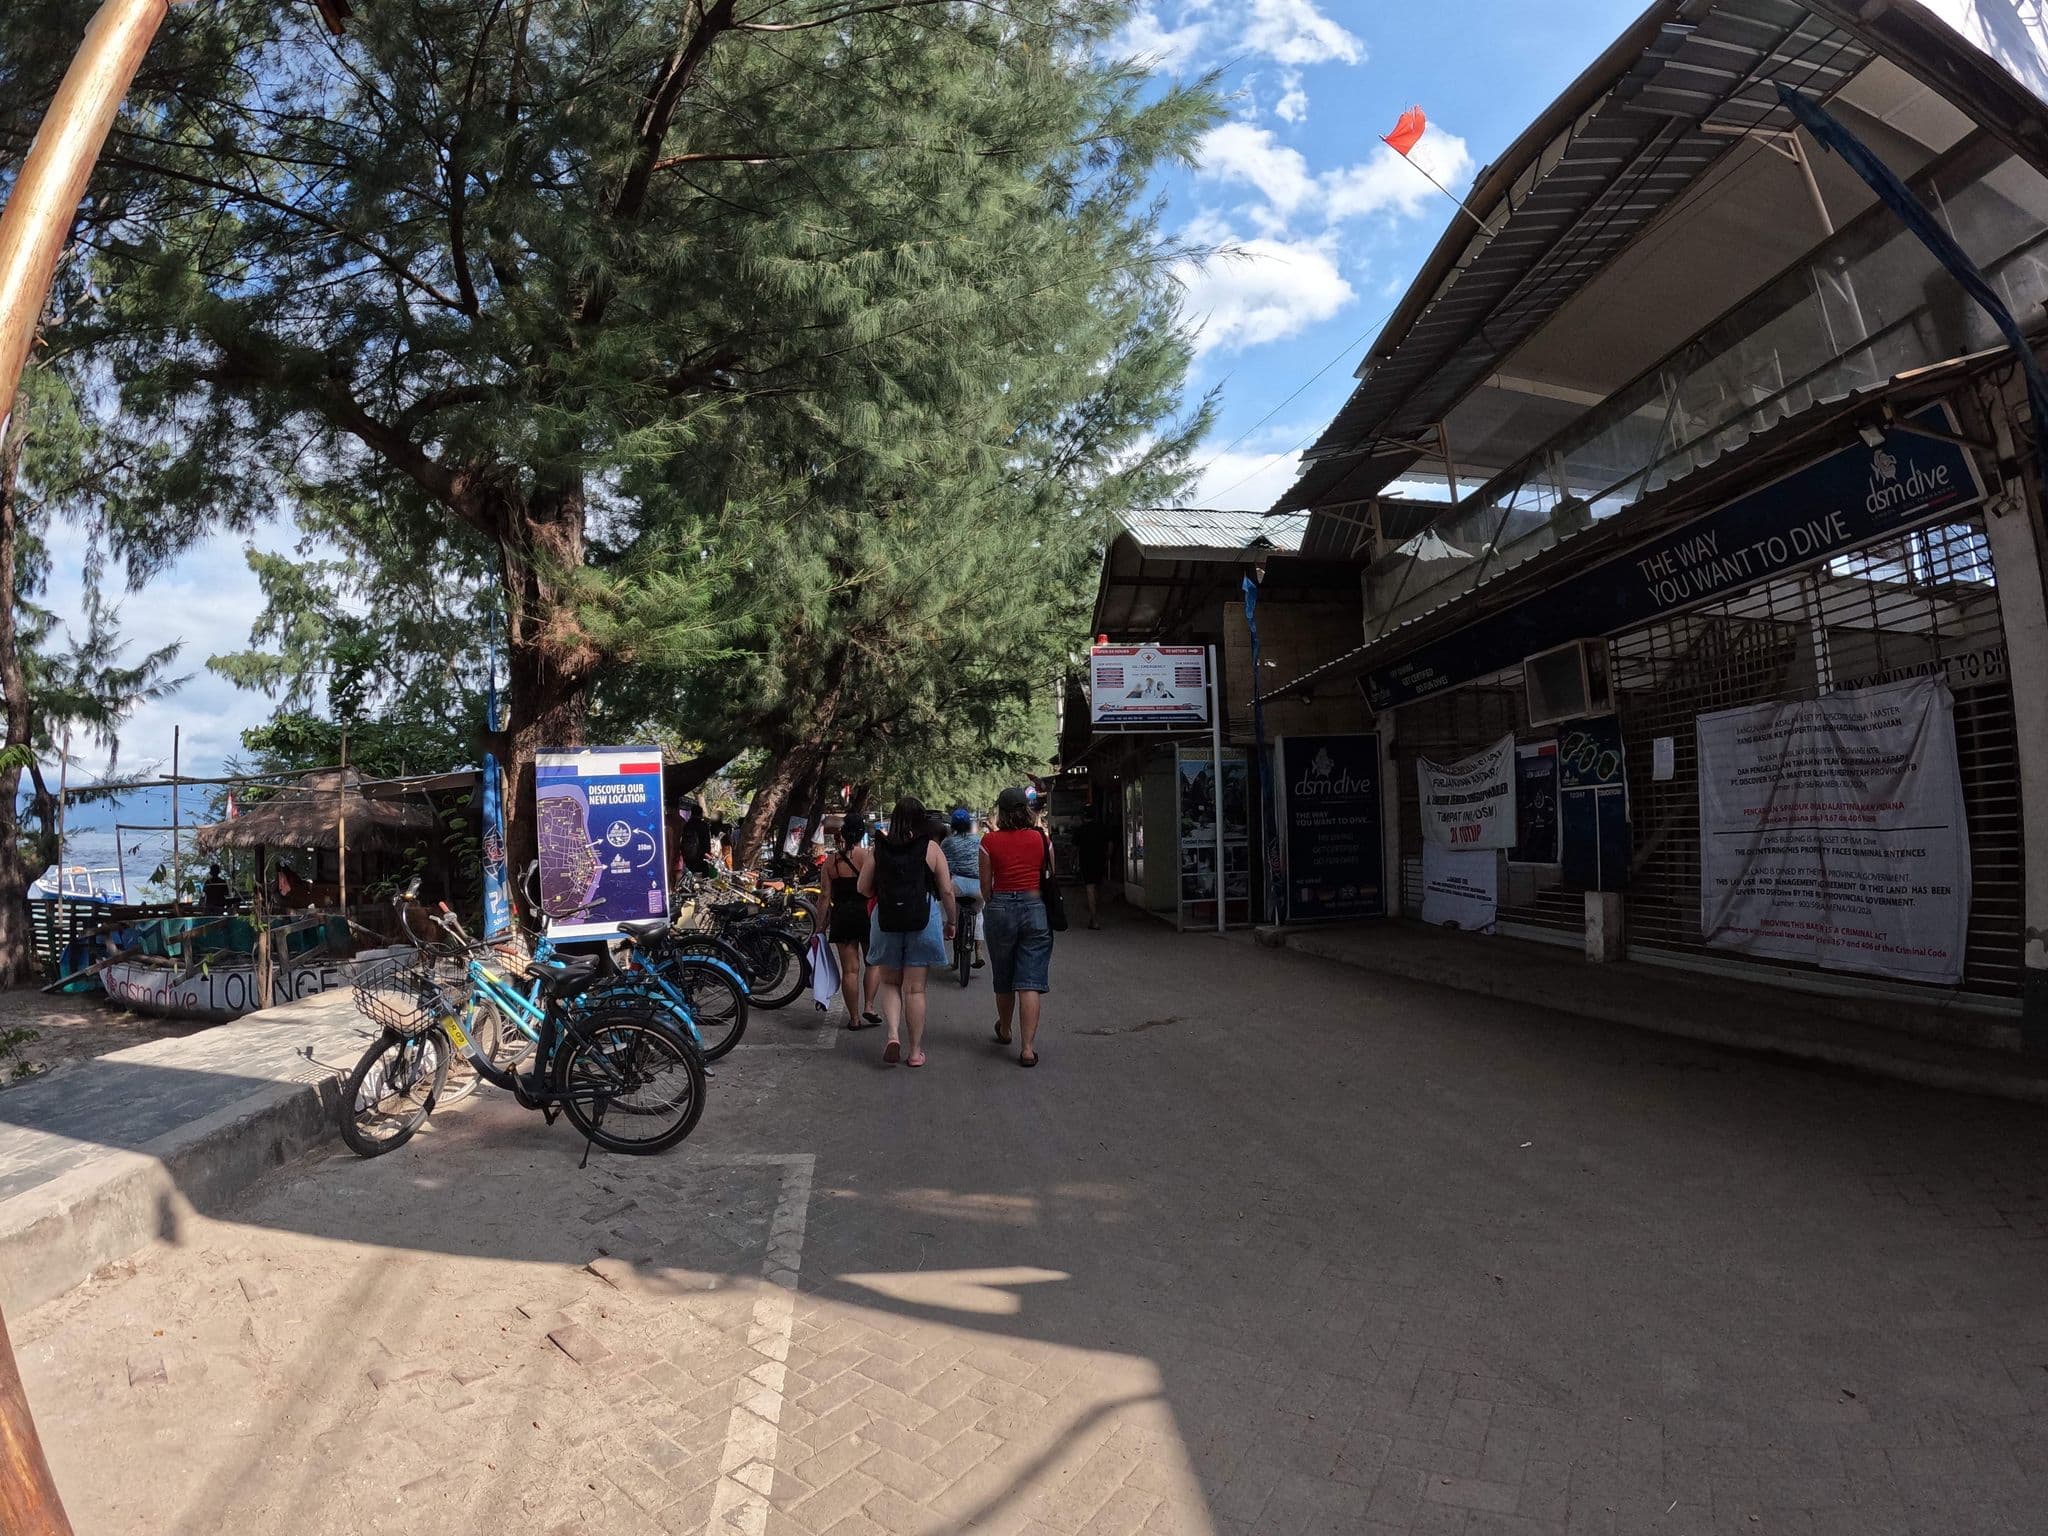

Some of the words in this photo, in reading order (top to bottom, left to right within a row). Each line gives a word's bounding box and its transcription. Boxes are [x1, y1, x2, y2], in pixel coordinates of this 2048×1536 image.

[1866, 475, 1906, 513] dsm
[1906, 457, 1950, 498] dive
[1636, 550, 1678, 583] THE
[1673, 529, 1721, 567] WAY
[1647, 574, 1691, 608] YOU
[1688, 548, 1753, 592] WANT
[1752, 536, 1788, 568] TO
[1788, 510, 1852, 556] DIVE
[1955, 653, 1980, 681] TO
[1983, 646, 2009, 676] DI
[1870, 706, 1900, 719] MASTER
[1294, 767, 1331, 795] dsm
[1333, 767, 1371, 794] dive
[588, 784, 626, 795] DISCOVER
[627, 783, 645, 793] OUR
[589, 795, 608, 805] NEW
[608, 794, 646, 804] LOCATION
[1296, 819, 1312, 827] YOU
[1313, 818, 1337, 826] WANT
[1338, 817, 1348, 825] TO
[1312, 810, 1329, 819] WAY
[1868, 884, 1884, 893] THIS
[1886, 885, 1908, 894] LAND
[1912, 886, 1928, 894] HAS
[1931, 886, 1952, 896] BEEN
[1840, 927, 1873, 938] CRIMINAL
[1846, 940, 1860, 949] and
[1882, 944, 1895, 953] the
[1895, 945, 1926, 956] Criminal
[1927, 948, 1947, 958] Code
[119, 966, 152, 1009] dsm
[155, 970, 198, 1009] dive
[210, 967, 339, 1011] LOUNGE
